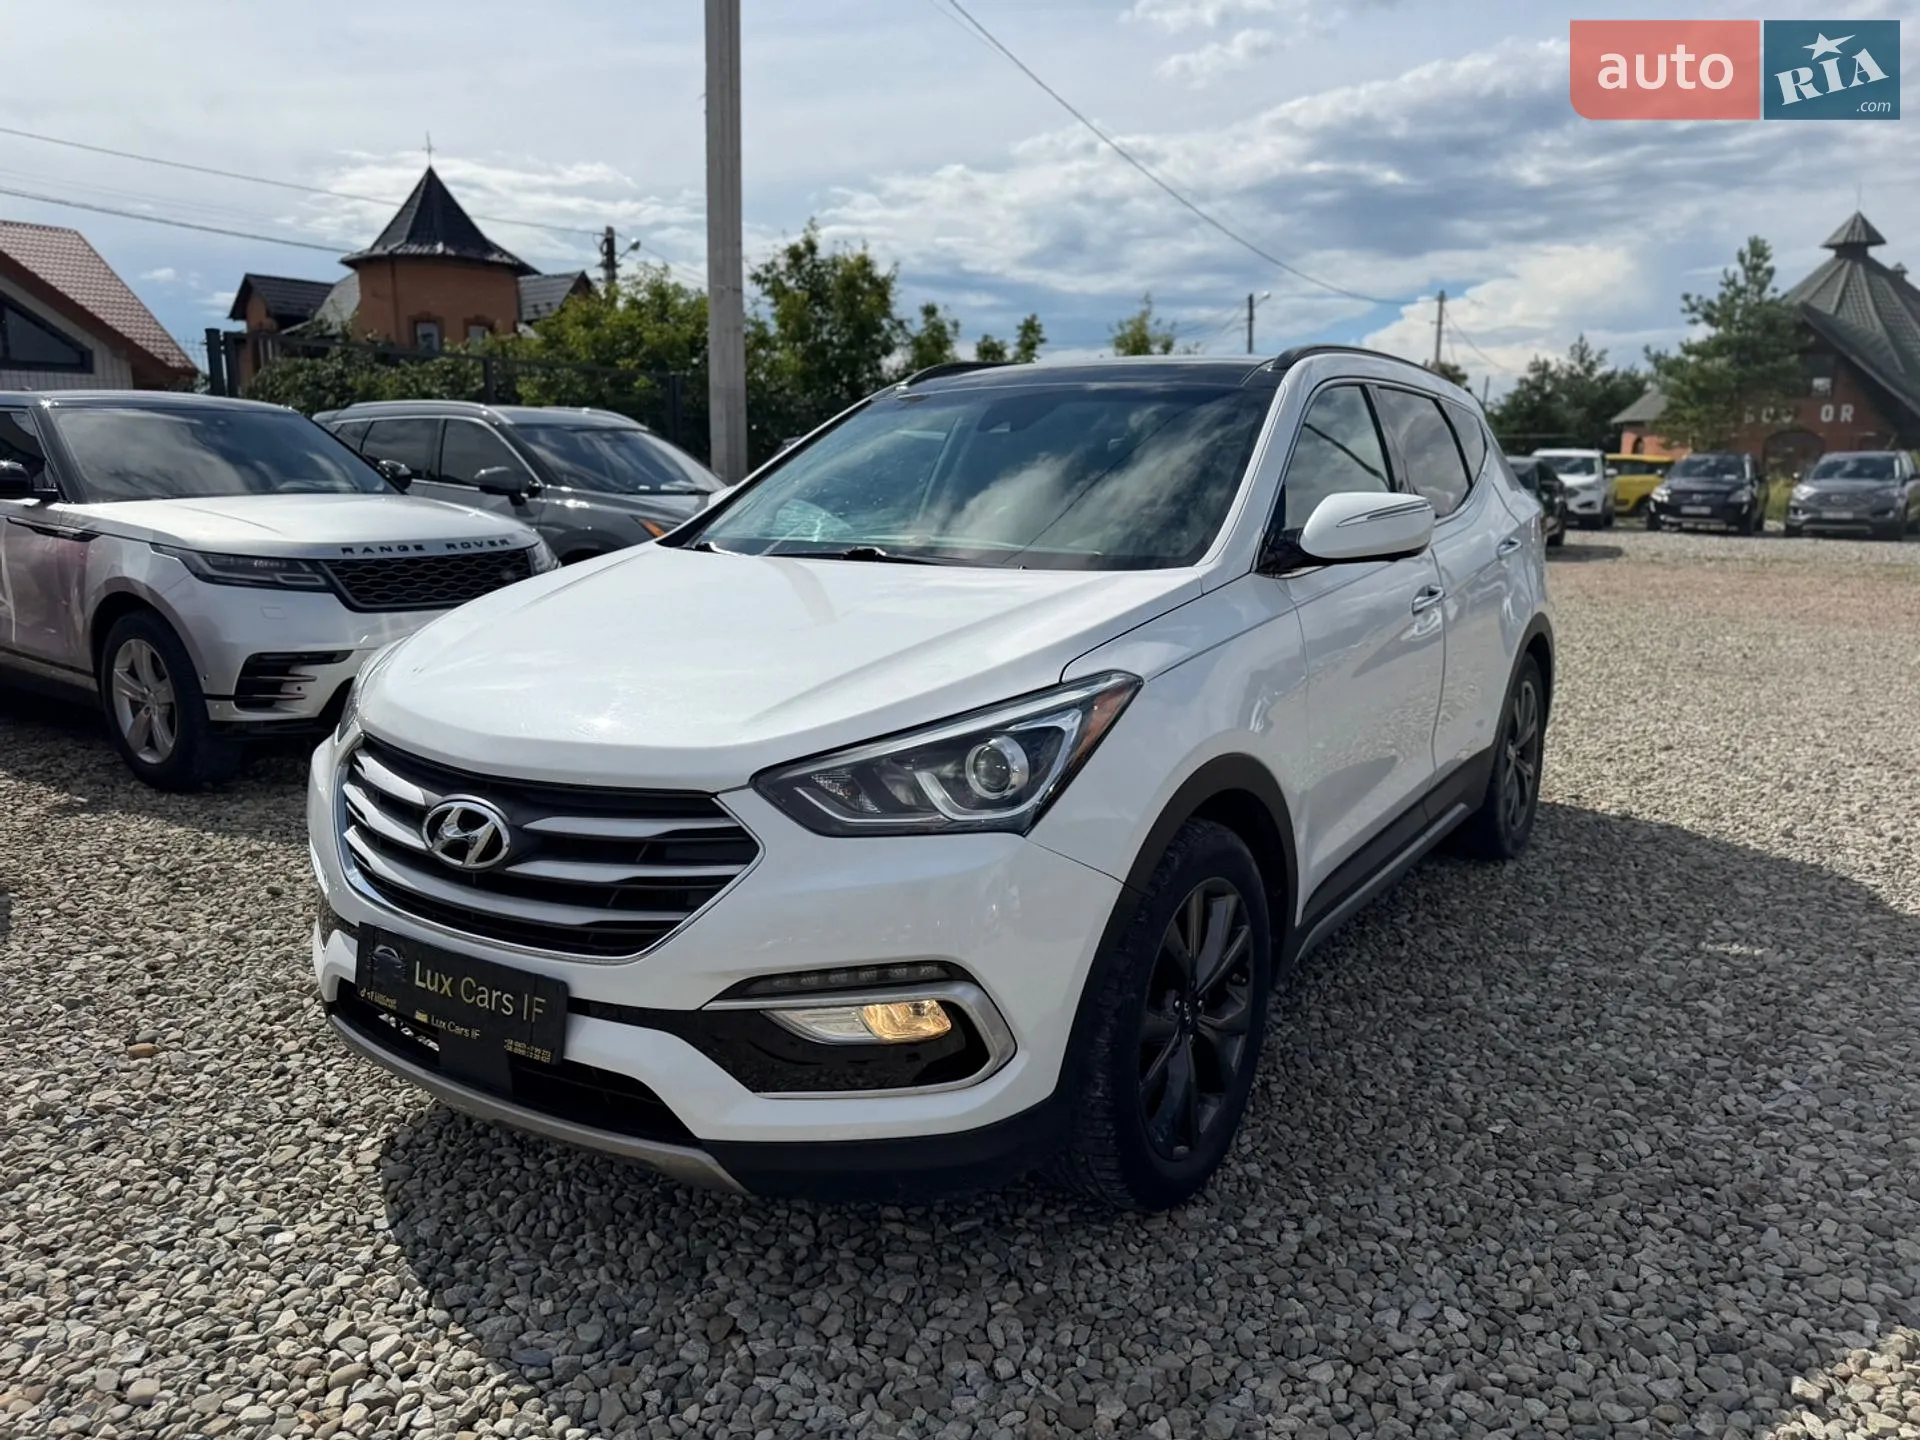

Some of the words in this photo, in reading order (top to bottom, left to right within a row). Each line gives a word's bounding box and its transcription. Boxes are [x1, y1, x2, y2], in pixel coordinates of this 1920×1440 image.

[340, 543, 425, 555] RANGE
[444, 538, 511, 551] ROVER
[414, 960, 453, 998] Lux
[459, 976, 514, 1016] Cars
[522, 992, 547, 1023] IF
[430, 1014, 447, 1030] Lux
[447, 1020, 470, 1038] Cars
